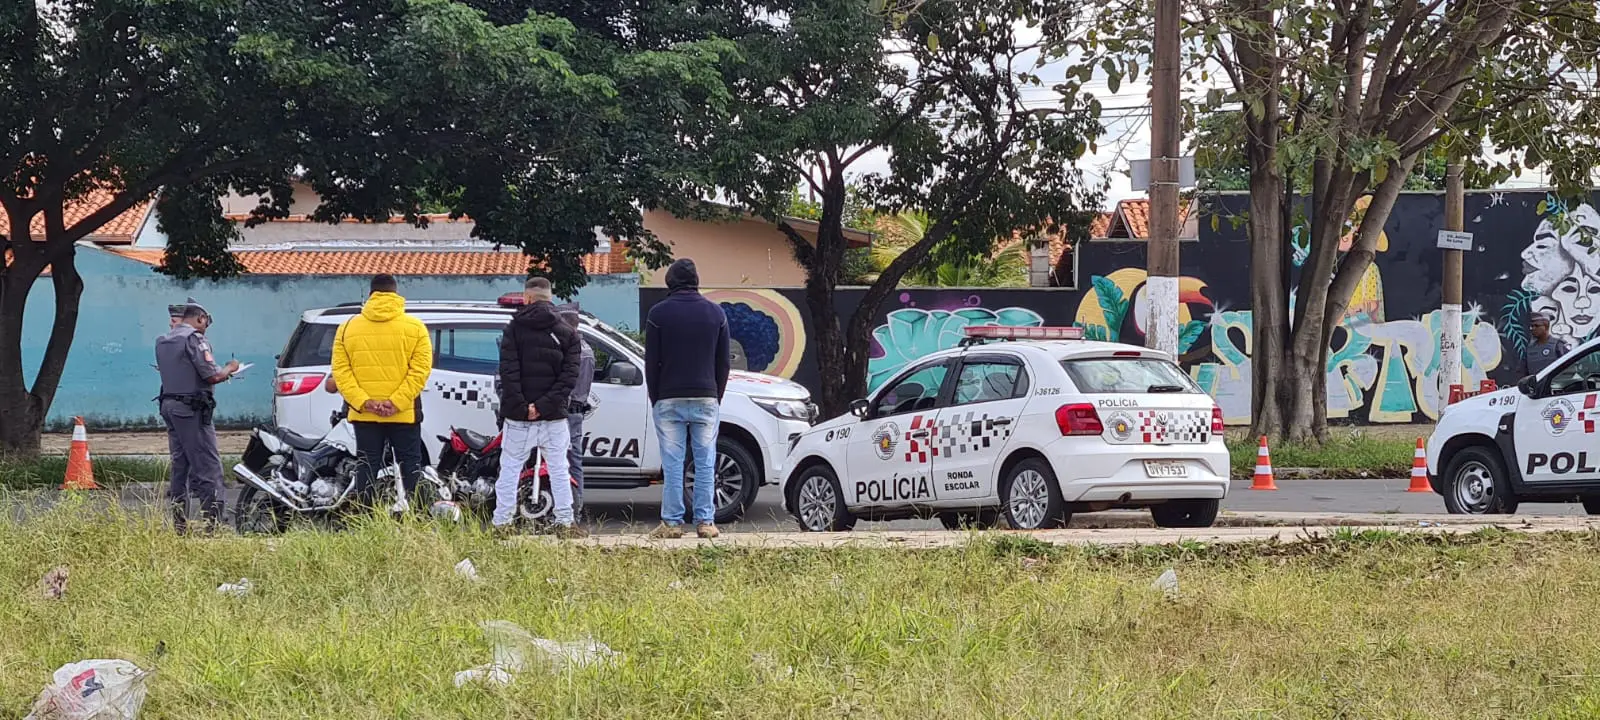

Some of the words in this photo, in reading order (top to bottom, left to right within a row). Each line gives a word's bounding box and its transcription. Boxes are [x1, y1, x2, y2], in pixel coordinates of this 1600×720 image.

[1099, 398, 1139, 407] POLÍCIA
[1500, 396, 1515, 406] 190
[836, 427, 850, 440] 190
[1526, 452, 1600, 475] POL
[947, 471, 974, 480] RONDA
[856, 472, 930, 502] POLÍCIA
[944, 481, 980, 491] ESCOLAR
